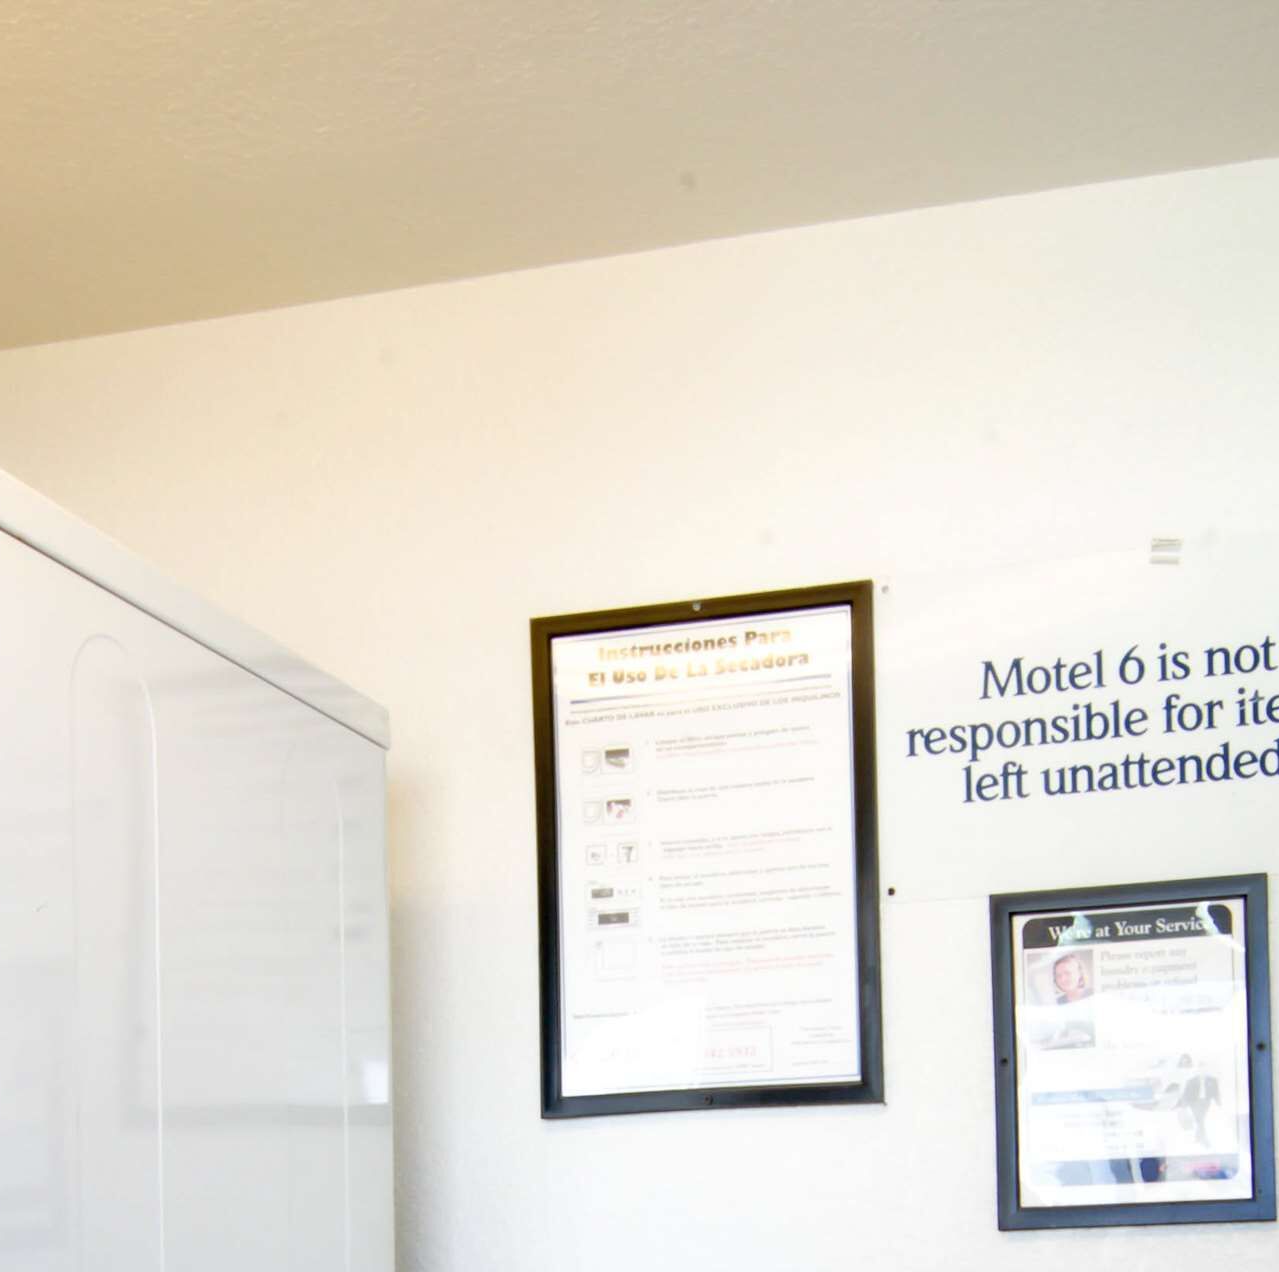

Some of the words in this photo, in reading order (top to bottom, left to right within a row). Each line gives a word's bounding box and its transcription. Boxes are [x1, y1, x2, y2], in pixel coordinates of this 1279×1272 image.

[598, 632, 738, 661] Instrucciones
[744, 628, 792, 645] Para
[588, 672, 605, 687] El
[613, 670, 647, 684] Uso
[655, 666, 679, 681] De
[687, 663, 707, 677] La
[715, 651, 810, 675] Secadora
[980, 649, 1106, 699] Motel
[1118, 645, 1146, 686] 6
[1157, 643, 1191, 682] is
[1203, 636, 1278, 677] not
[906, 699, 1149, 761] responsible
[1162, 694, 1224, 734] for
[963, 761, 1030, 803] left
[1095, 924, 1110, 937] at
[1114, 921, 1152, 936] Your
[1155, 917, 1210, 933] Servic
